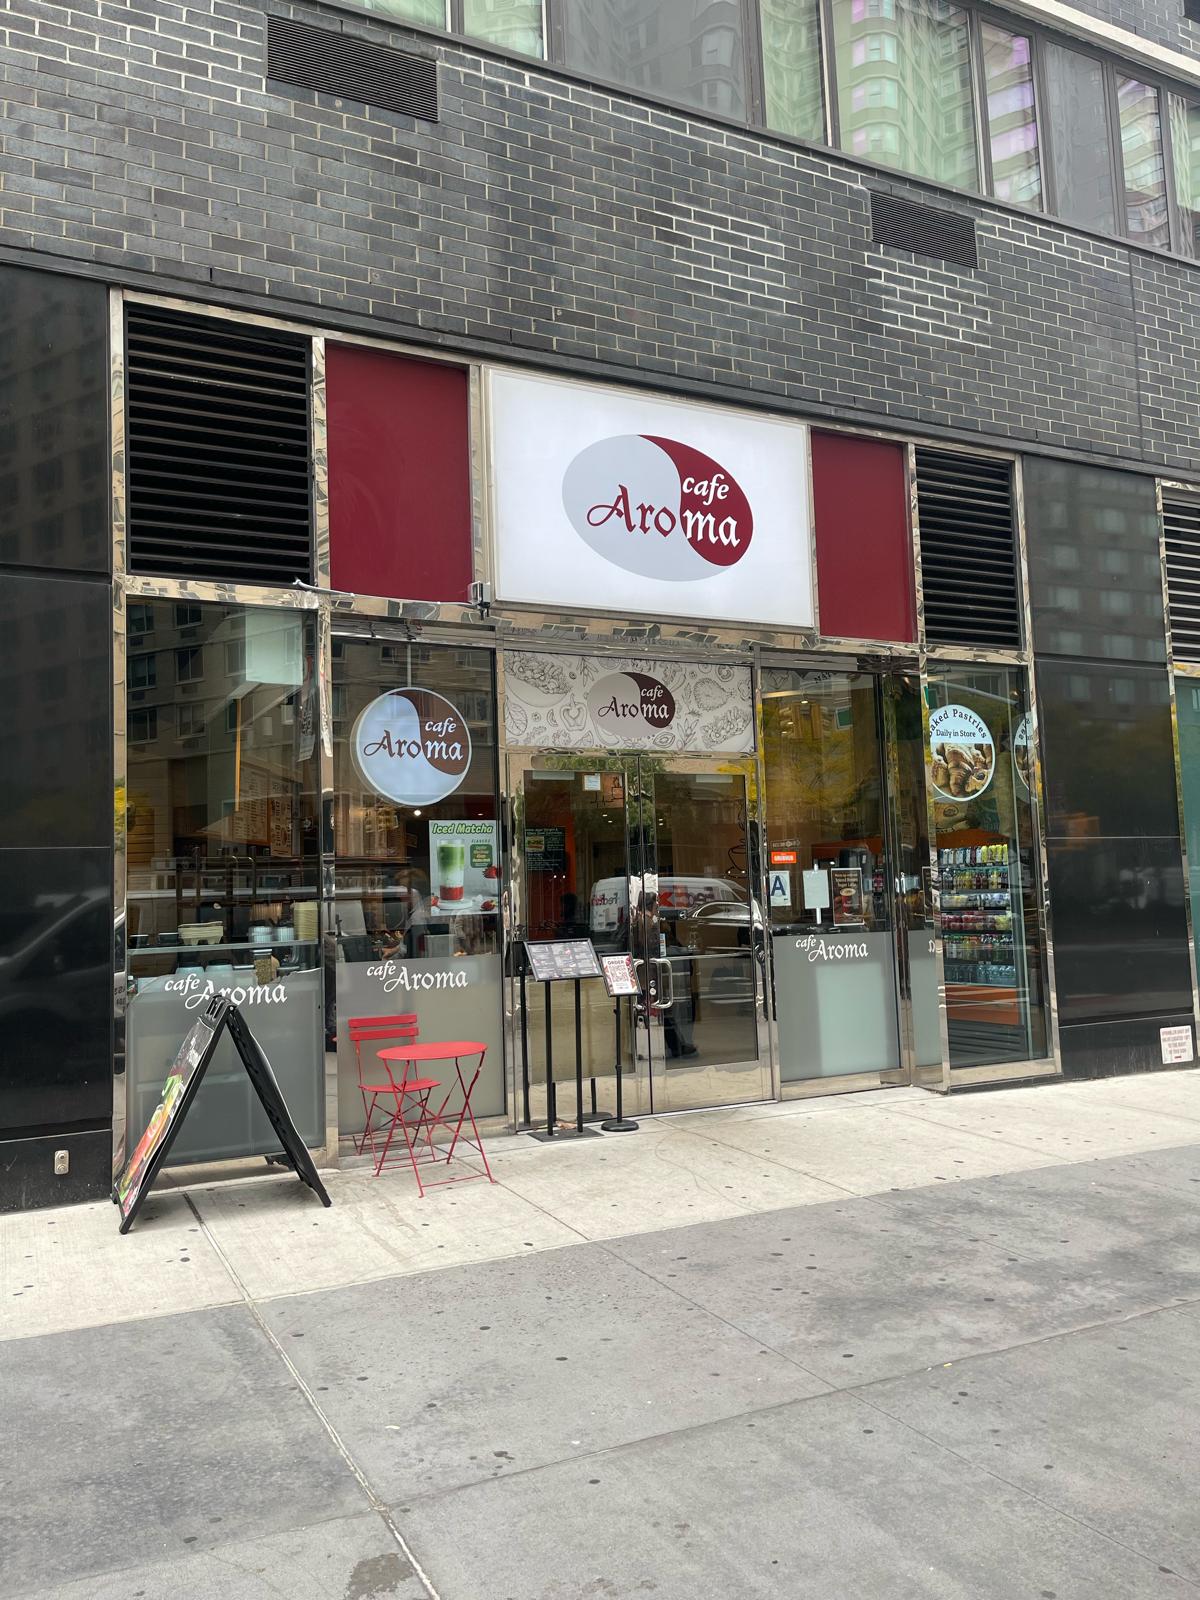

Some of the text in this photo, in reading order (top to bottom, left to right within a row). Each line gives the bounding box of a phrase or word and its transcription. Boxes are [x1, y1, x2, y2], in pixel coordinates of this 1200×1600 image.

[682, 473, 730, 505] cafe
[586, 484, 741, 548] Aroma
[641, 685, 664, 701] cafe
[598, 696, 669, 719] Aroma
[425, 717, 457, 737] cafe
[936, 730, 952, 738] Daily
[960, 730, 976, 738] Store
[952, 708, 987, 739] Pastries
[363, 729, 463, 760] Aroma
[432, 823, 493, 834] Iced Matcha
[771, 875, 786, 896] A
[795, 934, 868, 962] cafe Aroma
[164, 973, 200, 995] cafe
[366, 960, 468, 993] cafe Aroma
